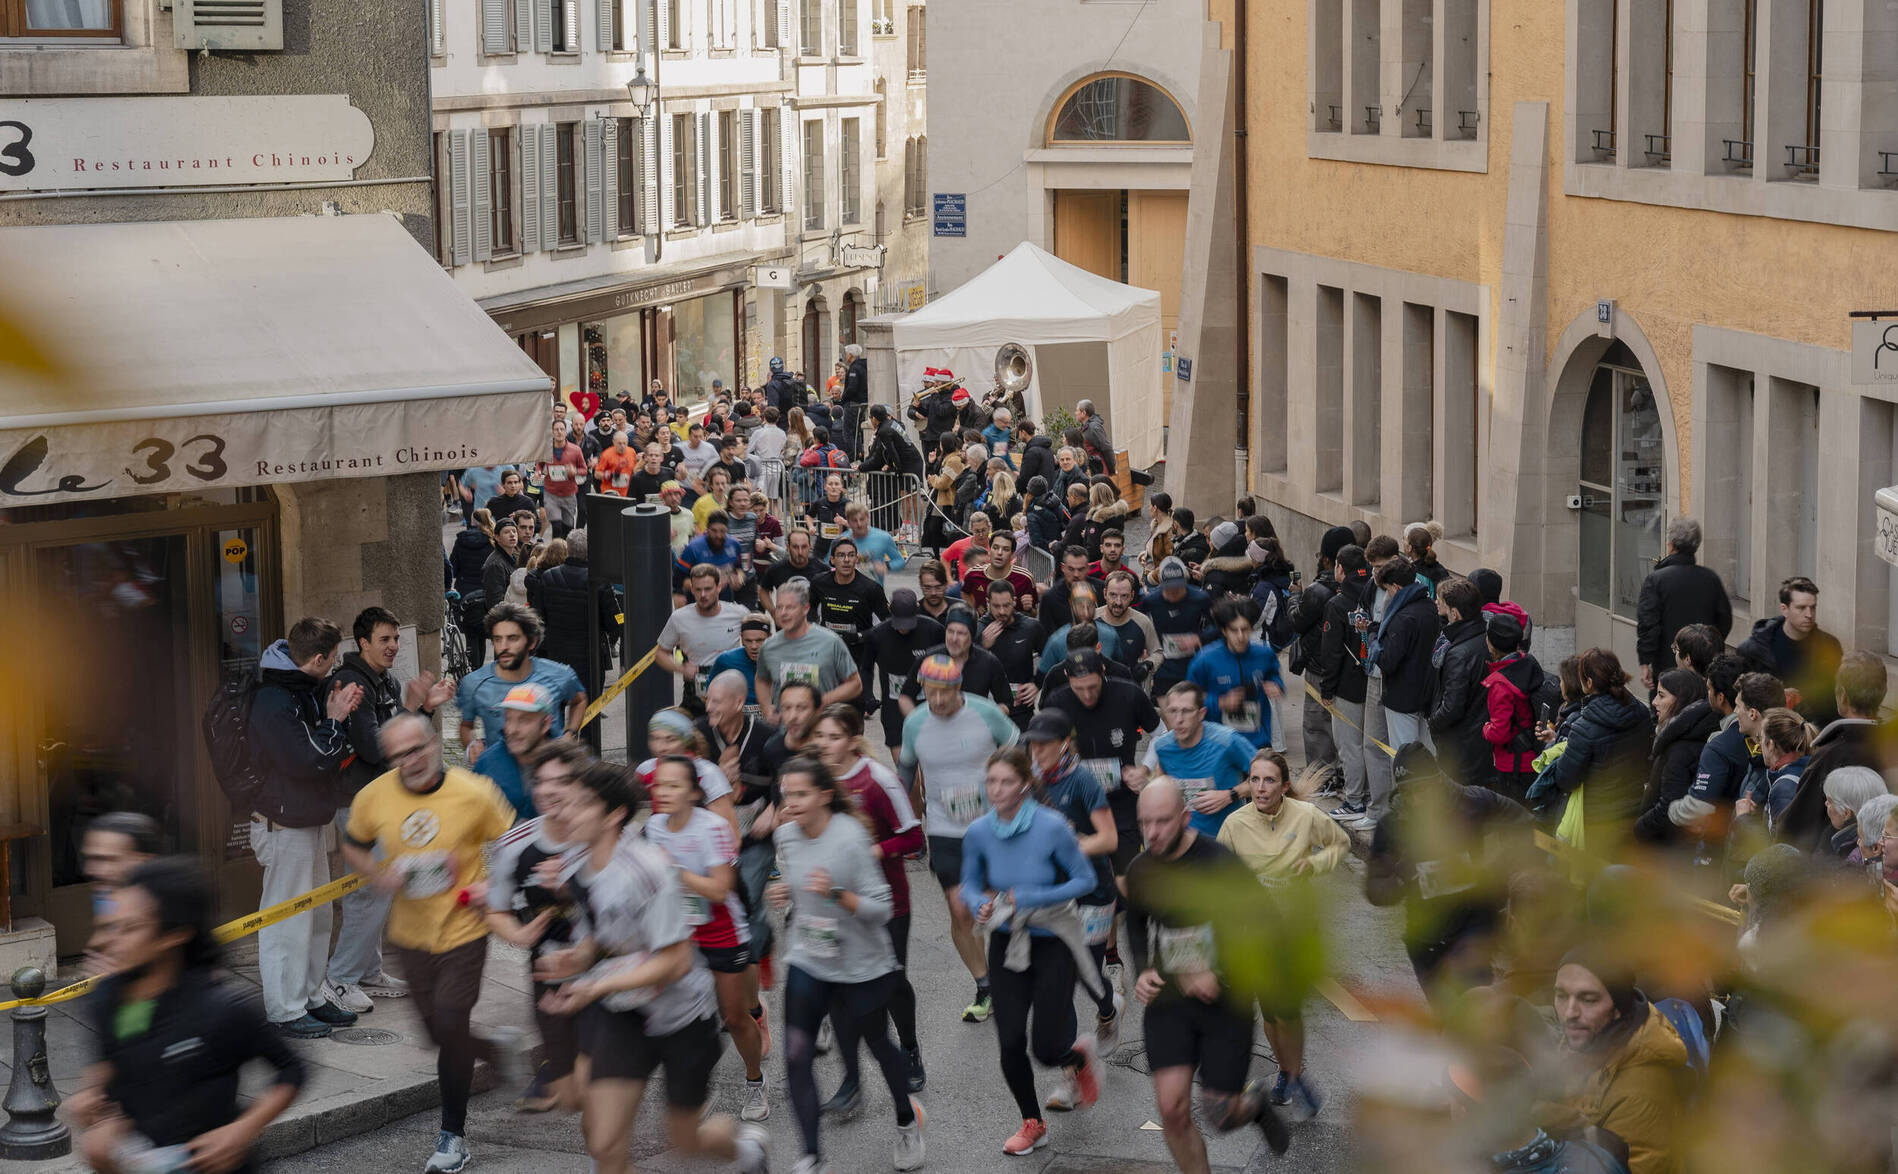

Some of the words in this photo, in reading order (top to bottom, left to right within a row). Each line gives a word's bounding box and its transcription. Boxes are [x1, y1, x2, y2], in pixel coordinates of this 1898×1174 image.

[72, 156, 233, 172] Restaurant
[252, 152, 354, 168] Chinois
[769, 270, 778, 280] G
[122, 434, 228, 484] 33
[256, 453, 384, 477] Restaurant
[395, 444, 478, 464] Chinois
[226, 546, 246, 556] POP
